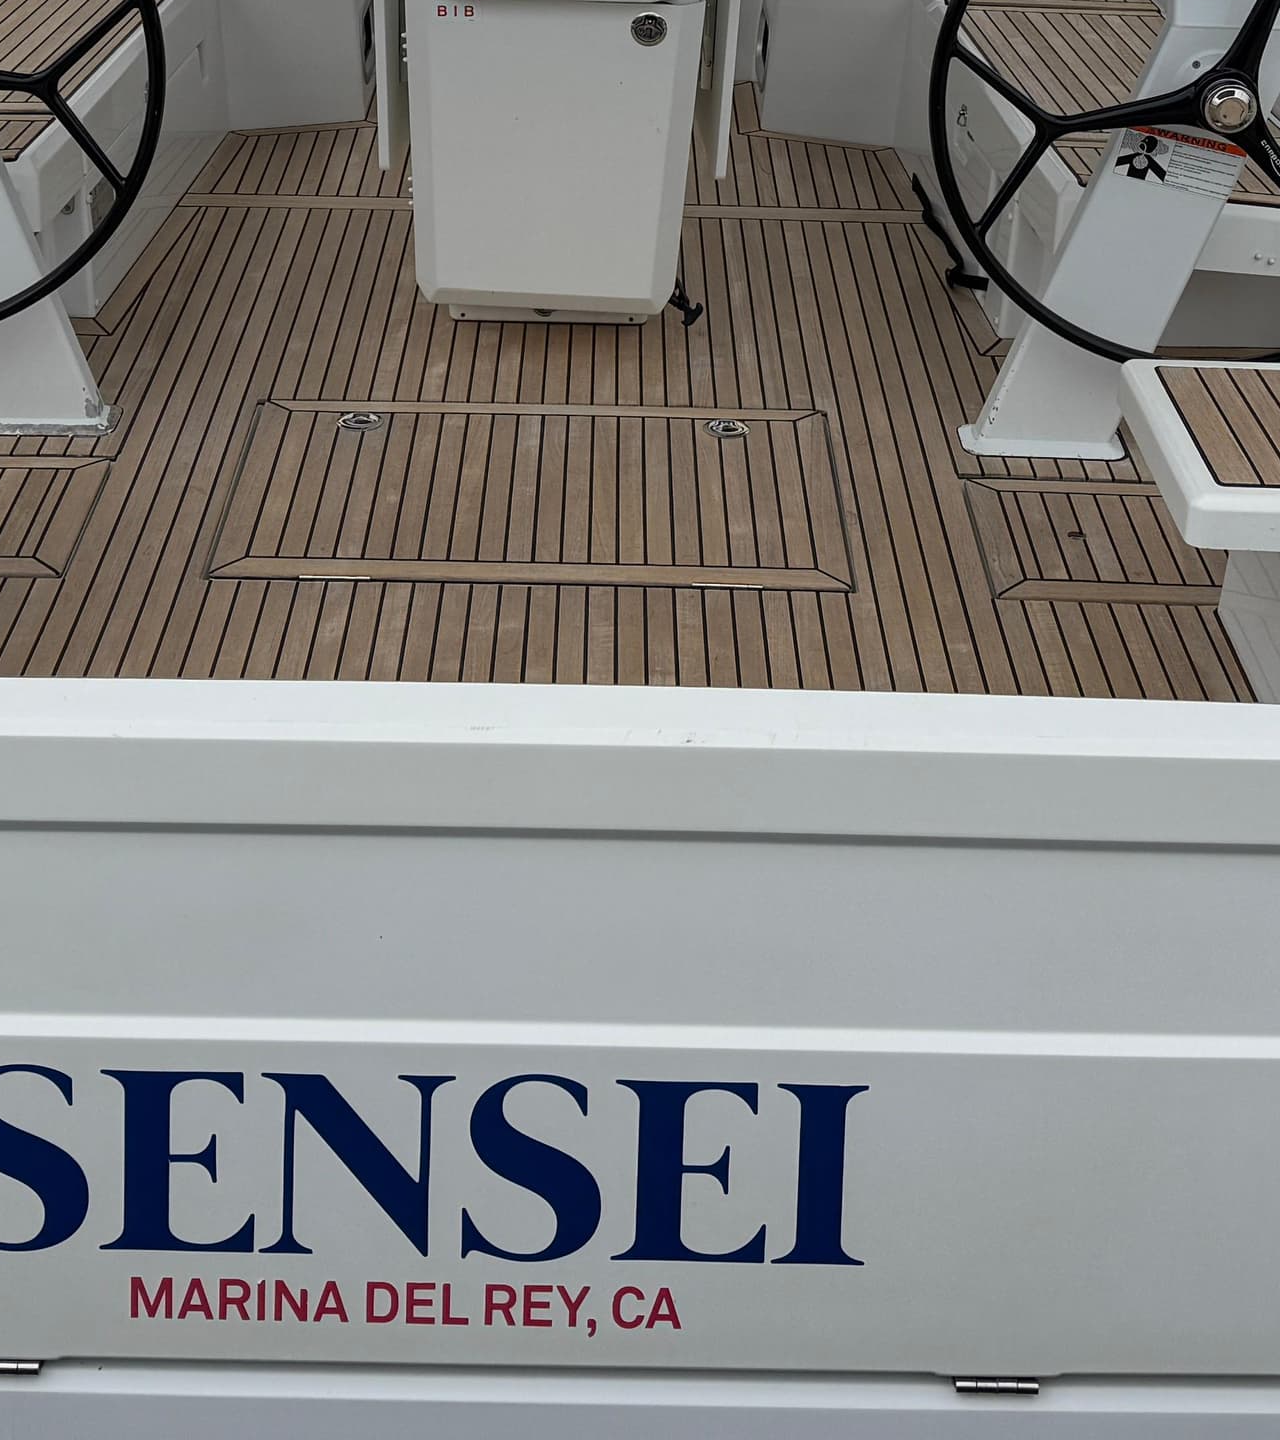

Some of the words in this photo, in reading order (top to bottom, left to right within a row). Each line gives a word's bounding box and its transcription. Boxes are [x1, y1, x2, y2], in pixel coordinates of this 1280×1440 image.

[437, 5, 474, 17] BIB
[1157, 127, 1227, 151] WARNING
[128, 1275, 350, 1325] MARINA
[364, 1280, 470, 1327] DEL
[483, 1283, 599, 1339] REY,
[611, 1286, 683, 1331] CA
